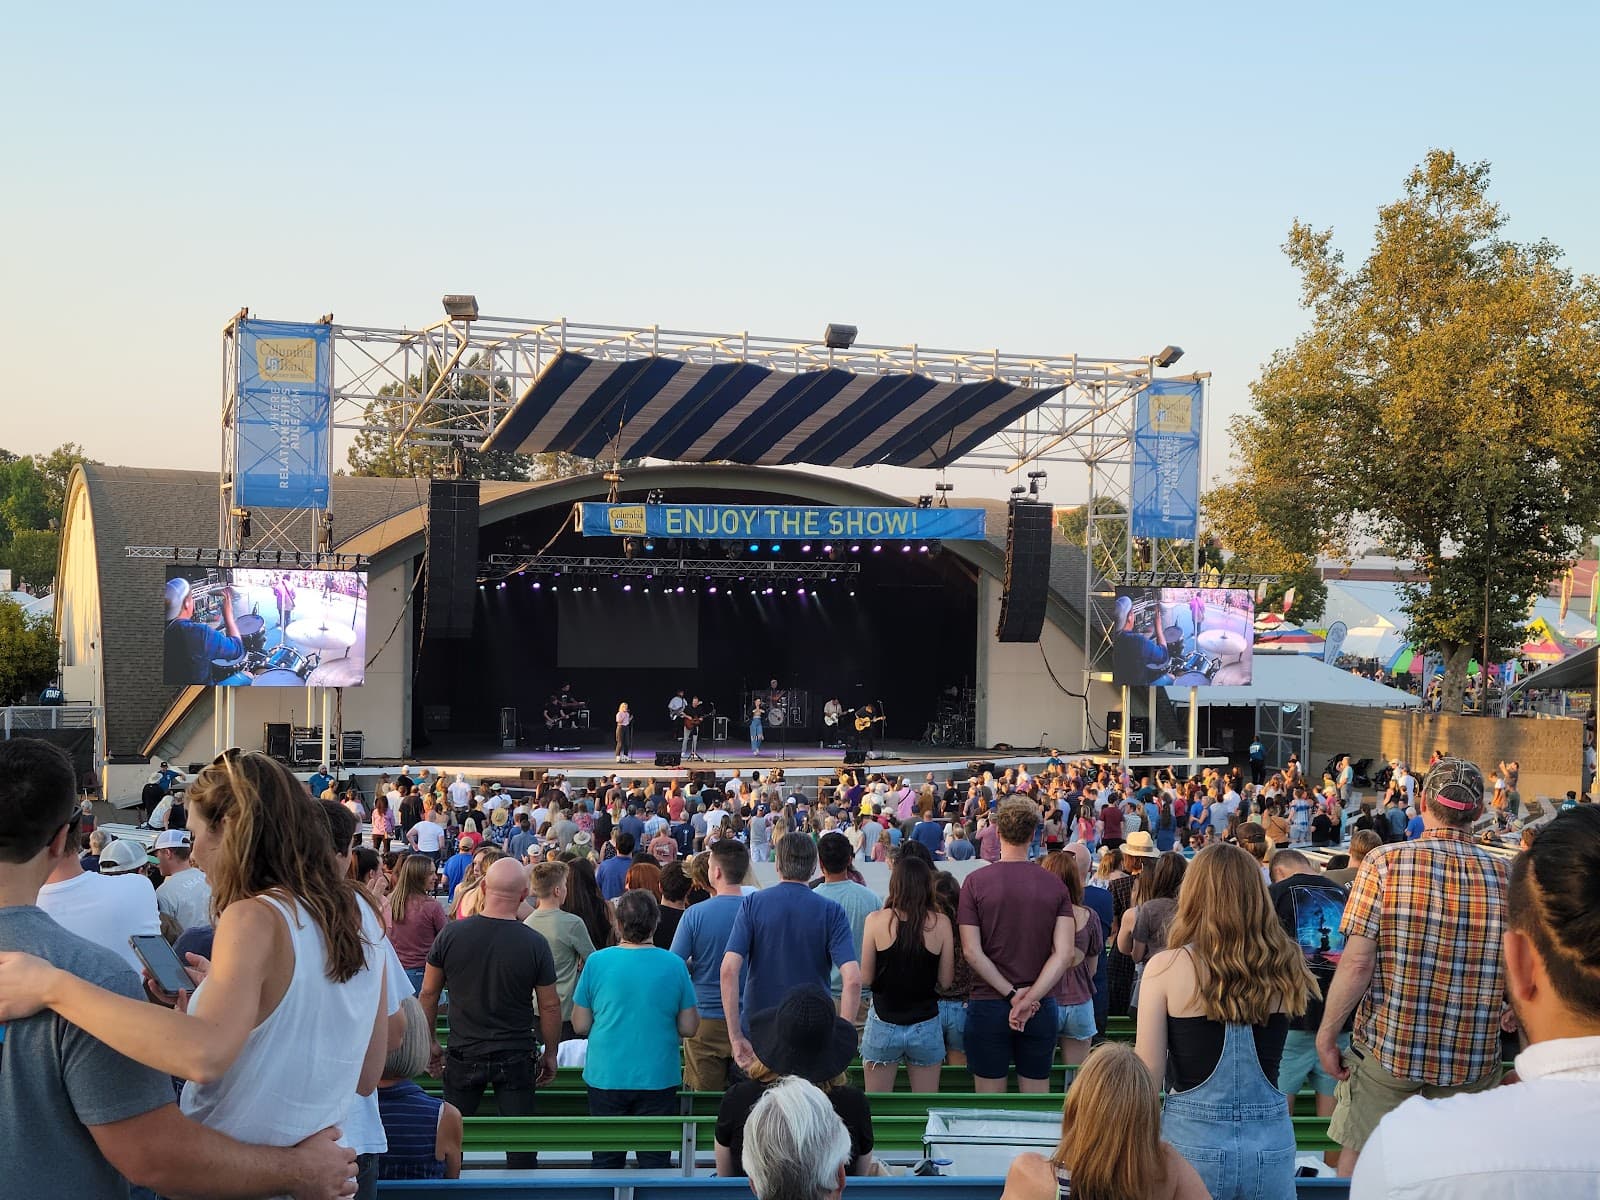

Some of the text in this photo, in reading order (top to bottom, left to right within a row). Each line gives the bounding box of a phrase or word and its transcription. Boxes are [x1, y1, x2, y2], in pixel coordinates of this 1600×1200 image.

[270, 387, 281, 431] WHERE
[291, 388, 301, 450] RULE.COM
[279, 388, 291, 489] RELATIONSHIPS
[610, 507, 644, 519] Columbia
[624, 519, 642, 529] Bank
[665, 508, 918, 535] ENJOY THE SHOW!
[46, 690, 60, 698] STAFF
